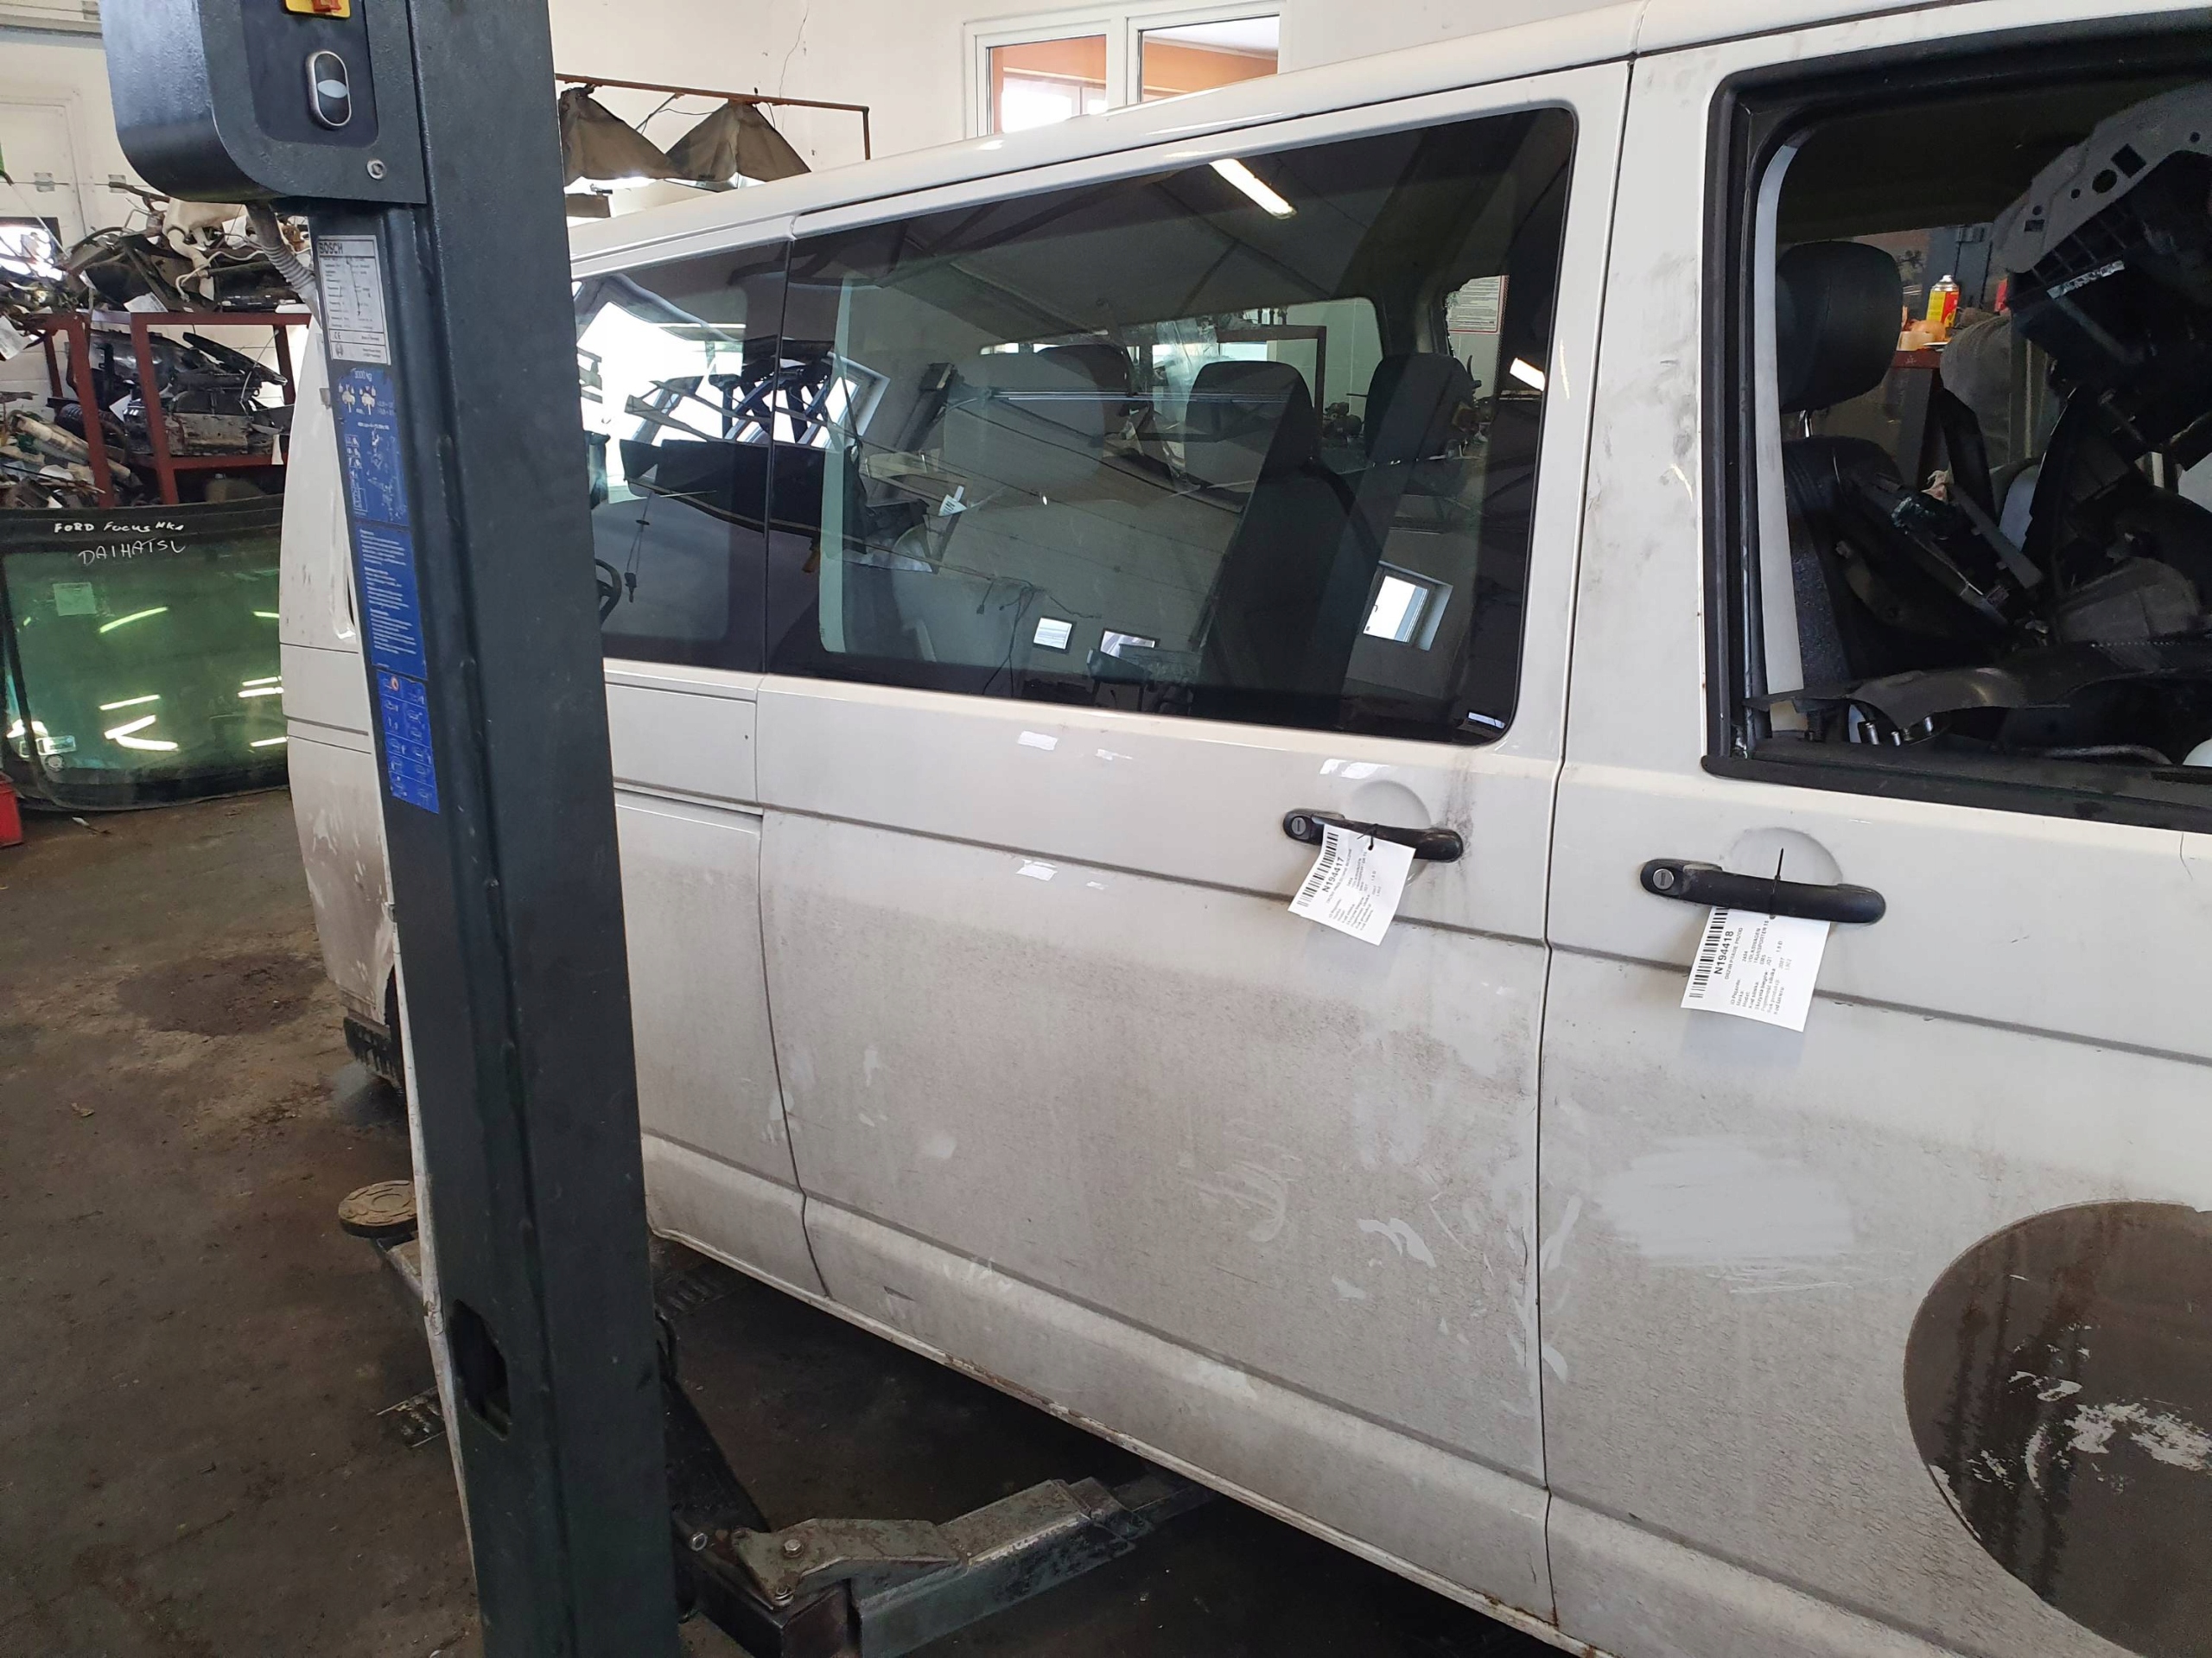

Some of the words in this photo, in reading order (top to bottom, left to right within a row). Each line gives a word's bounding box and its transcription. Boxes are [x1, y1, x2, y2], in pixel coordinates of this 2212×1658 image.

[319, 242, 344, 255] BOSCH
[1322, 856, 1344, 893] N194417
[1713, 931, 1734, 975] N194418
